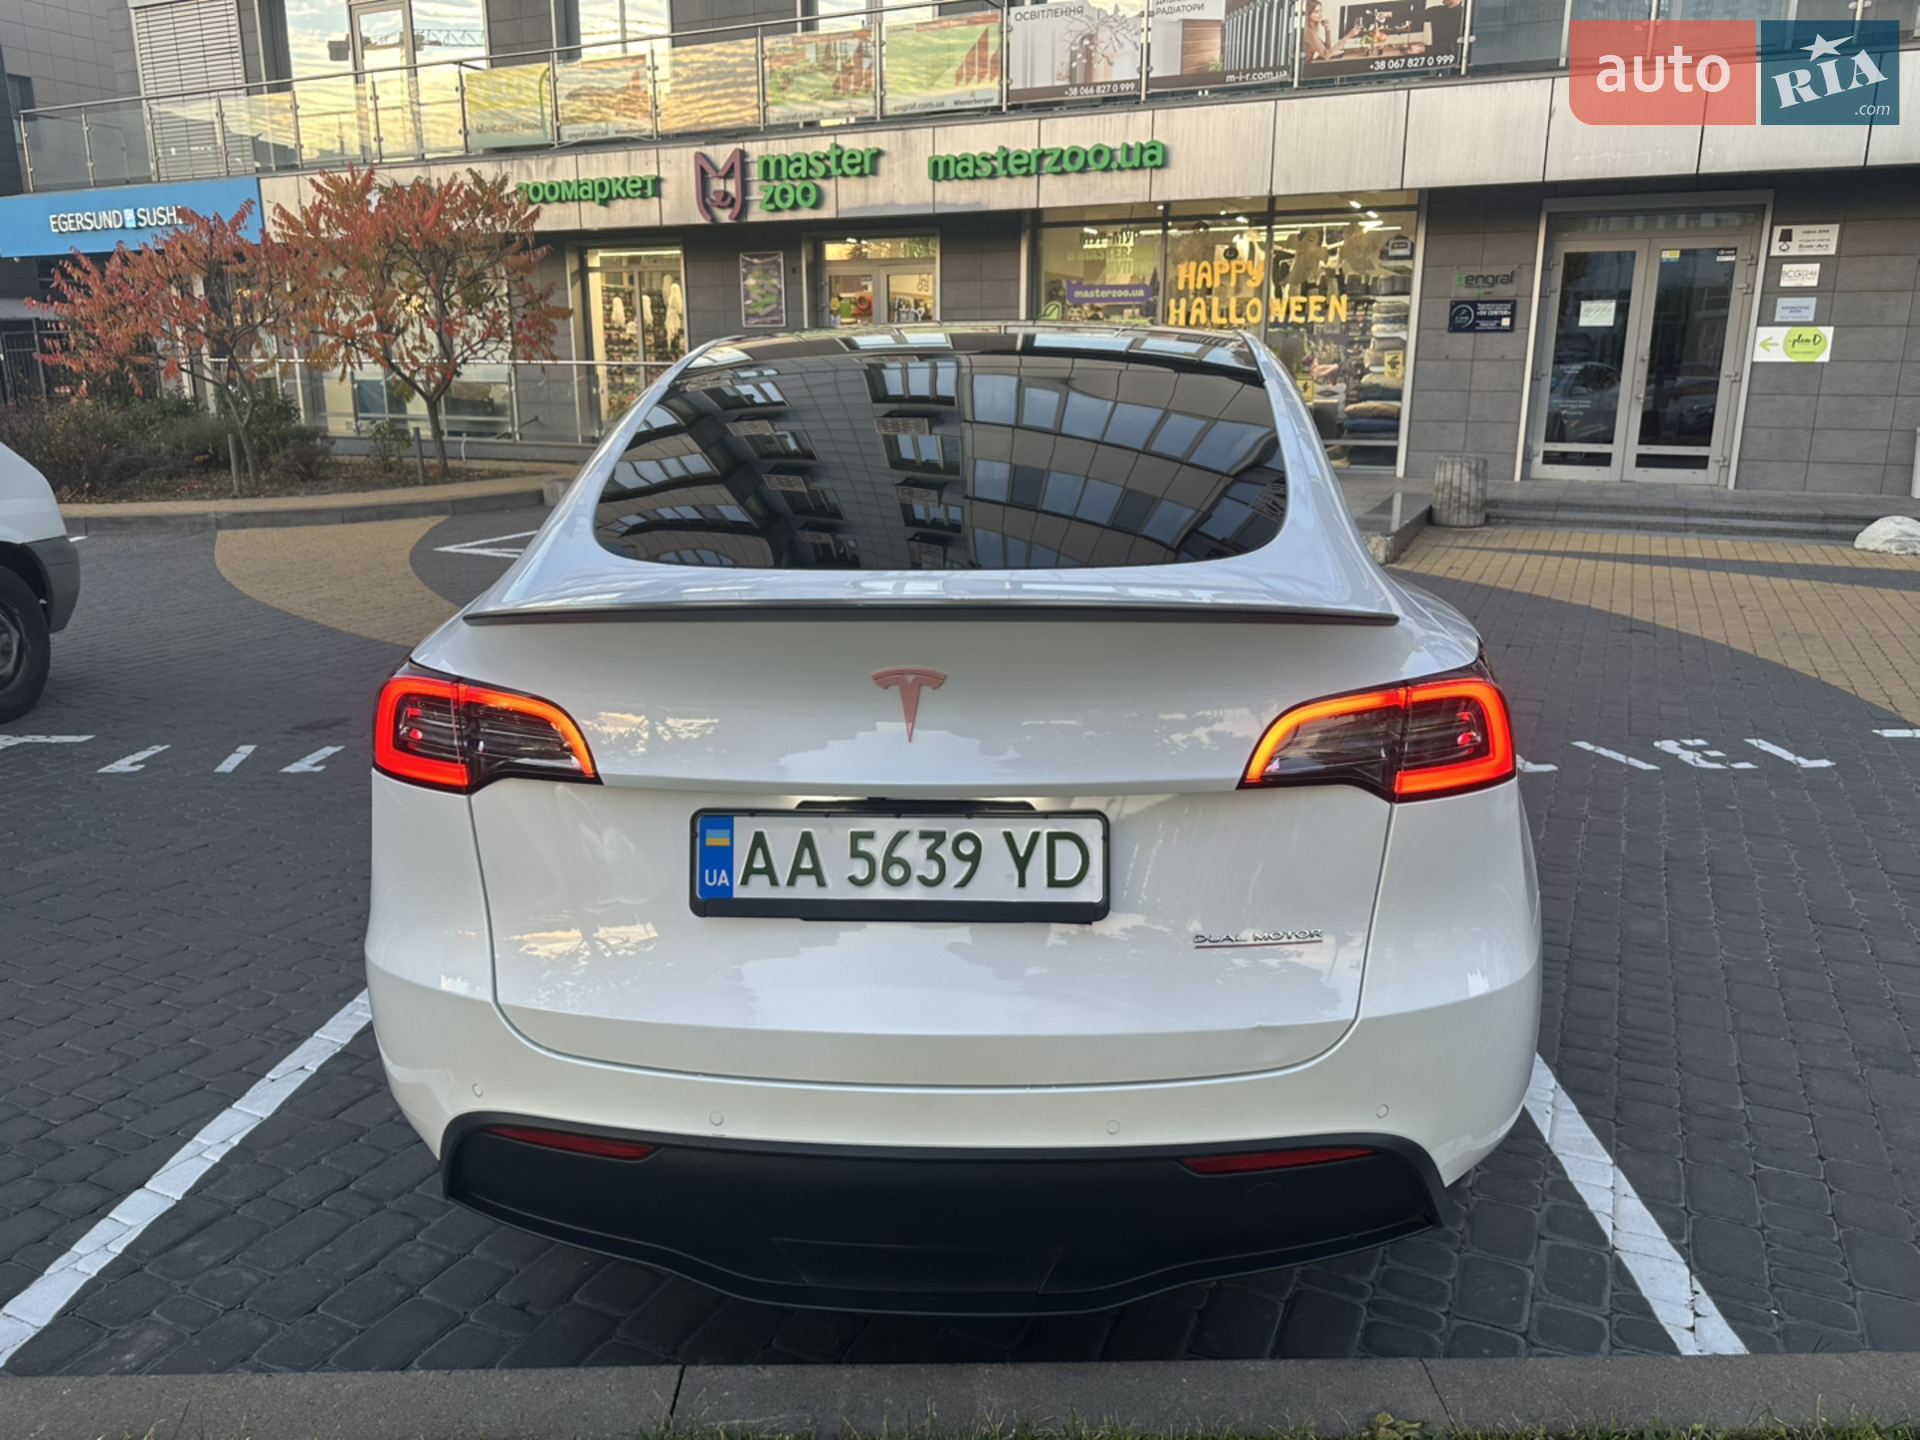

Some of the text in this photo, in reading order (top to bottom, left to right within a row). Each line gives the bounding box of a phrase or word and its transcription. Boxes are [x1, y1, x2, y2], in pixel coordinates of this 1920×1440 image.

[1014, 6, 1084, 22] ОСВІТЛЕННЯ
[1155, 3, 1204, 15] РАДІАТОРИ
[1387, 59, 1405, 69] 067
[1407, 57, 1425, 68] 827
[1427, 56, 1434, 66] 0
[1436, 54, 1455, 65] 999
[1226, 70, 1288, 83] m-i-r.com.ua
[1112, 83, 1118, 93] 0
[1120, 82, 1135, 92] 999
[757, 143, 881, 180] master
[928, 140, 1166, 181] masterzoo.ua
[759, 180, 820, 212] zoo
[49, 210, 123, 233] EGERSUND
[1177, 259, 1265, 291] HAPPY
[1074, 288, 1145, 299] masterzoo.ua
[1168, 294, 1348, 326] HALLOWEEN
[739, 829, 1091, 888] AA 5639 YD
[704, 868, 730, 886] UA
[1193, 928, 1323, 944] DUAL MOTOR
